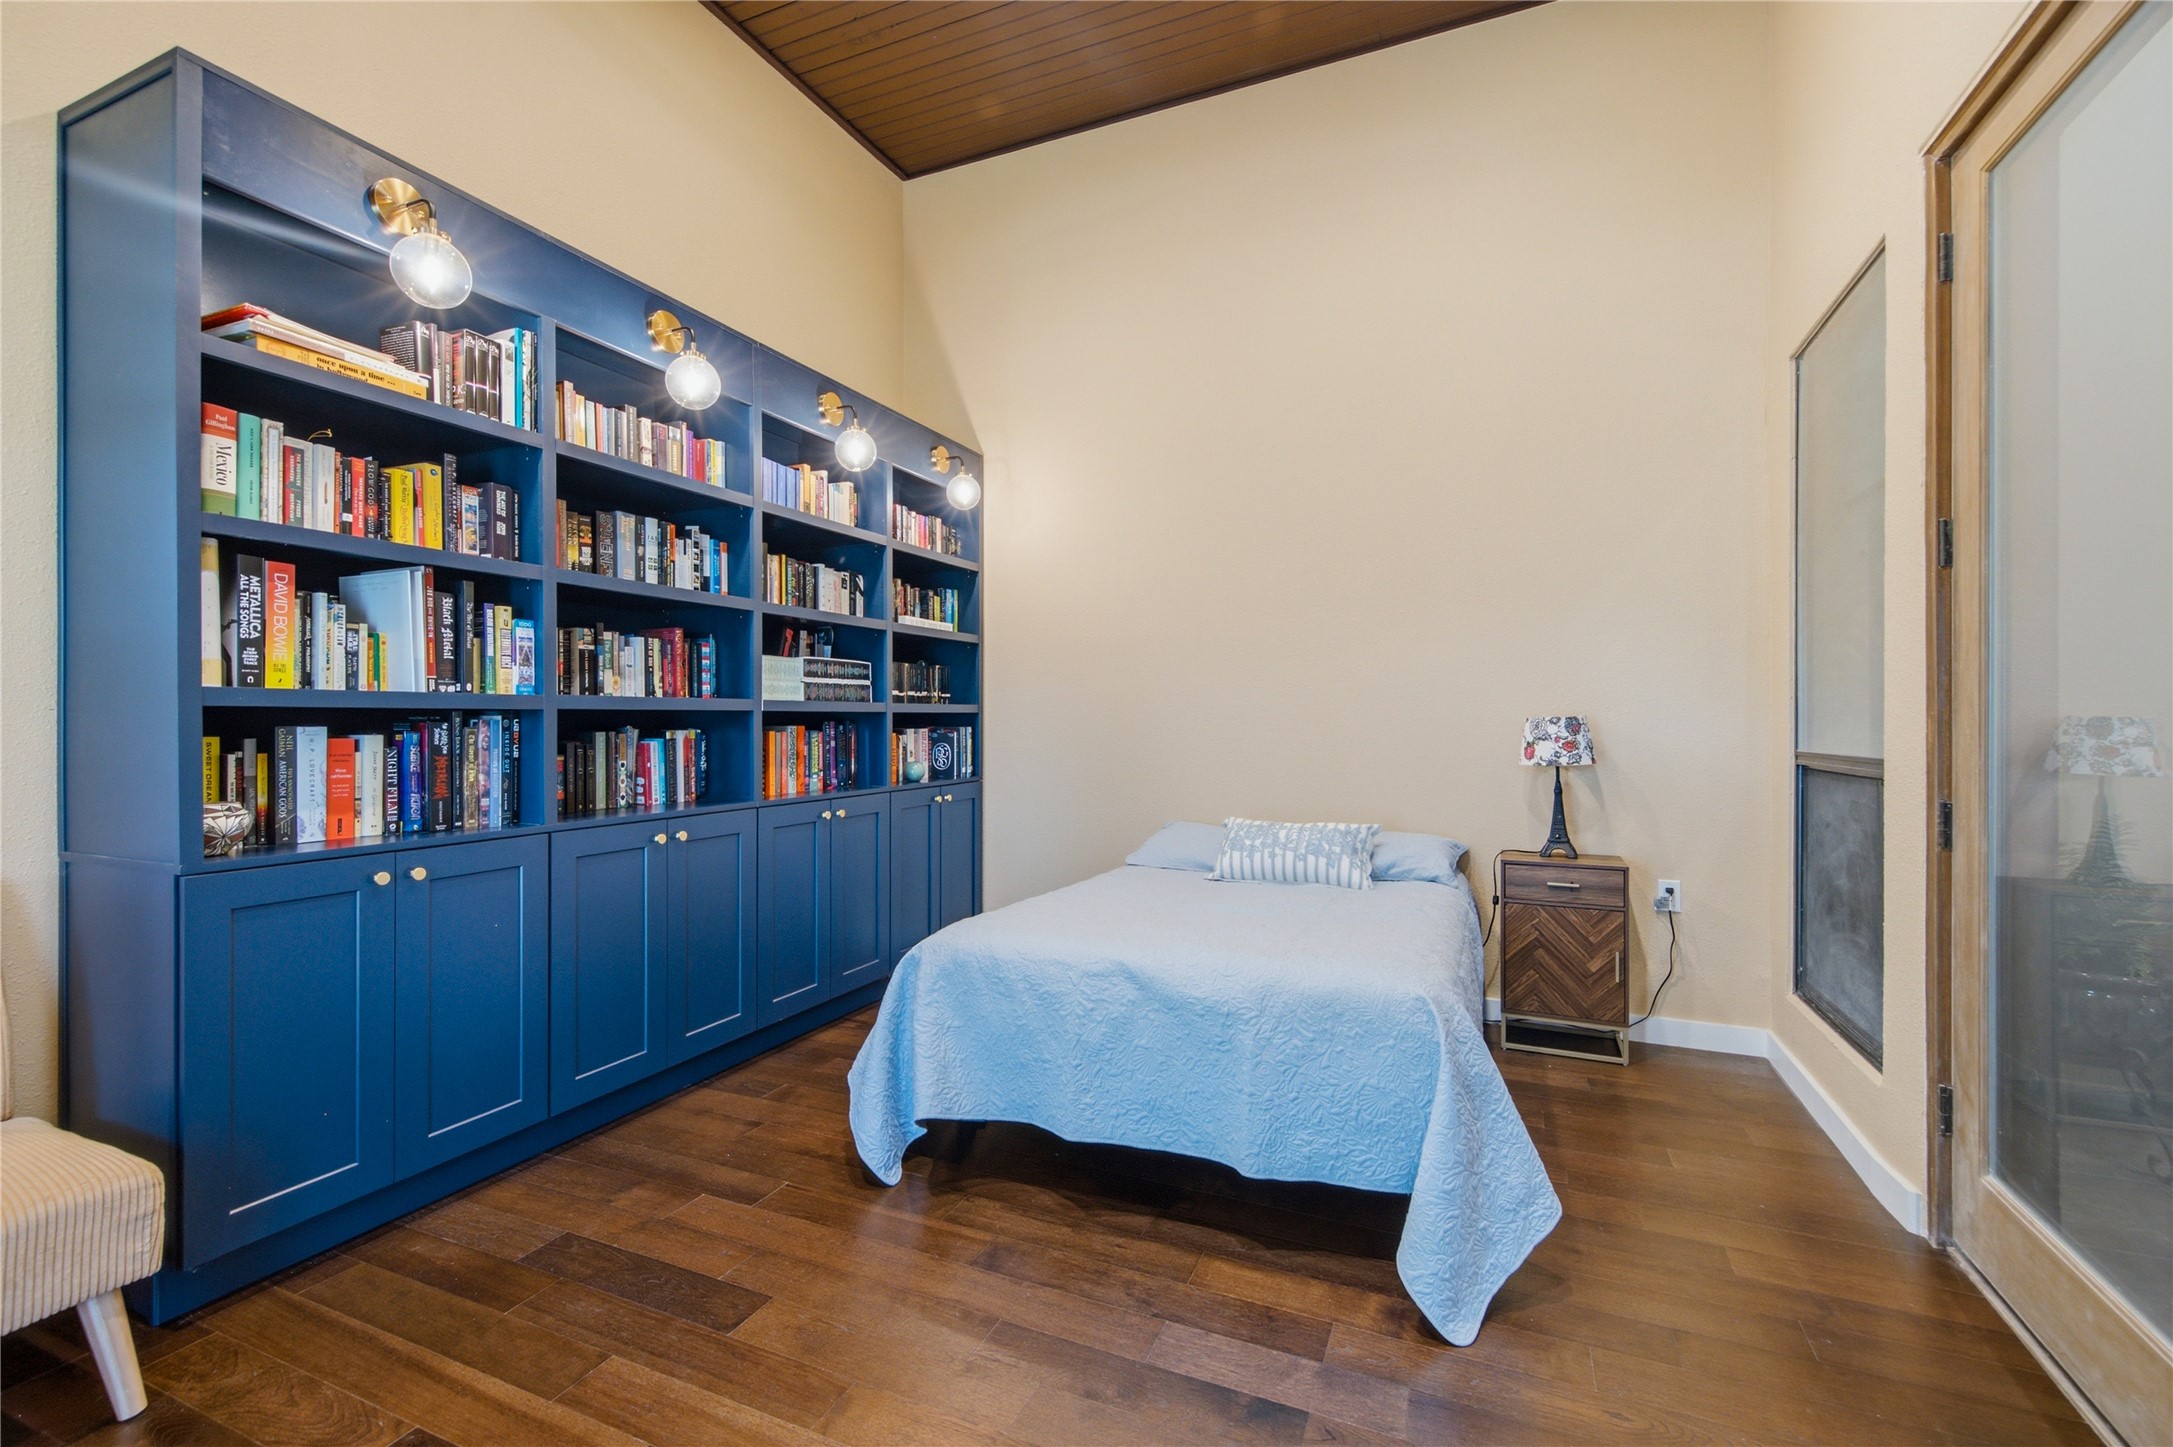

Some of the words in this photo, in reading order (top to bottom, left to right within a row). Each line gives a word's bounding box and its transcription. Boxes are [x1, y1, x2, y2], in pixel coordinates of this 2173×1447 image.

[317, 357, 336, 367] once
[339, 363, 358, 374] upon
[368, 372, 385, 382] time
[205, 419, 237, 431] Gillingham
[215, 413, 228, 423] Paul
[216, 442, 232, 486] Mexico
[239, 574, 249, 590] ALL
[274, 573, 288, 614] DAVID
[239, 592, 249, 610] THE
[250, 575, 261, 639] METALLICA
[442, 596, 453, 625] Black
[239, 611, 249, 639] SONGS
[273, 616, 288, 661] BOWIE
[441, 627, 454, 659] Metal
[278, 729, 286, 757] GAIMAN
[286, 735, 294, 750] NEIL
[309, 738, 315, 747] H.
[278, 760, 287, 797] AMERICAN
[387, 748, 398, 784] NIGHT
[278, 798, 287, 818] GODS
[387, 787, 398, 814] FILM
